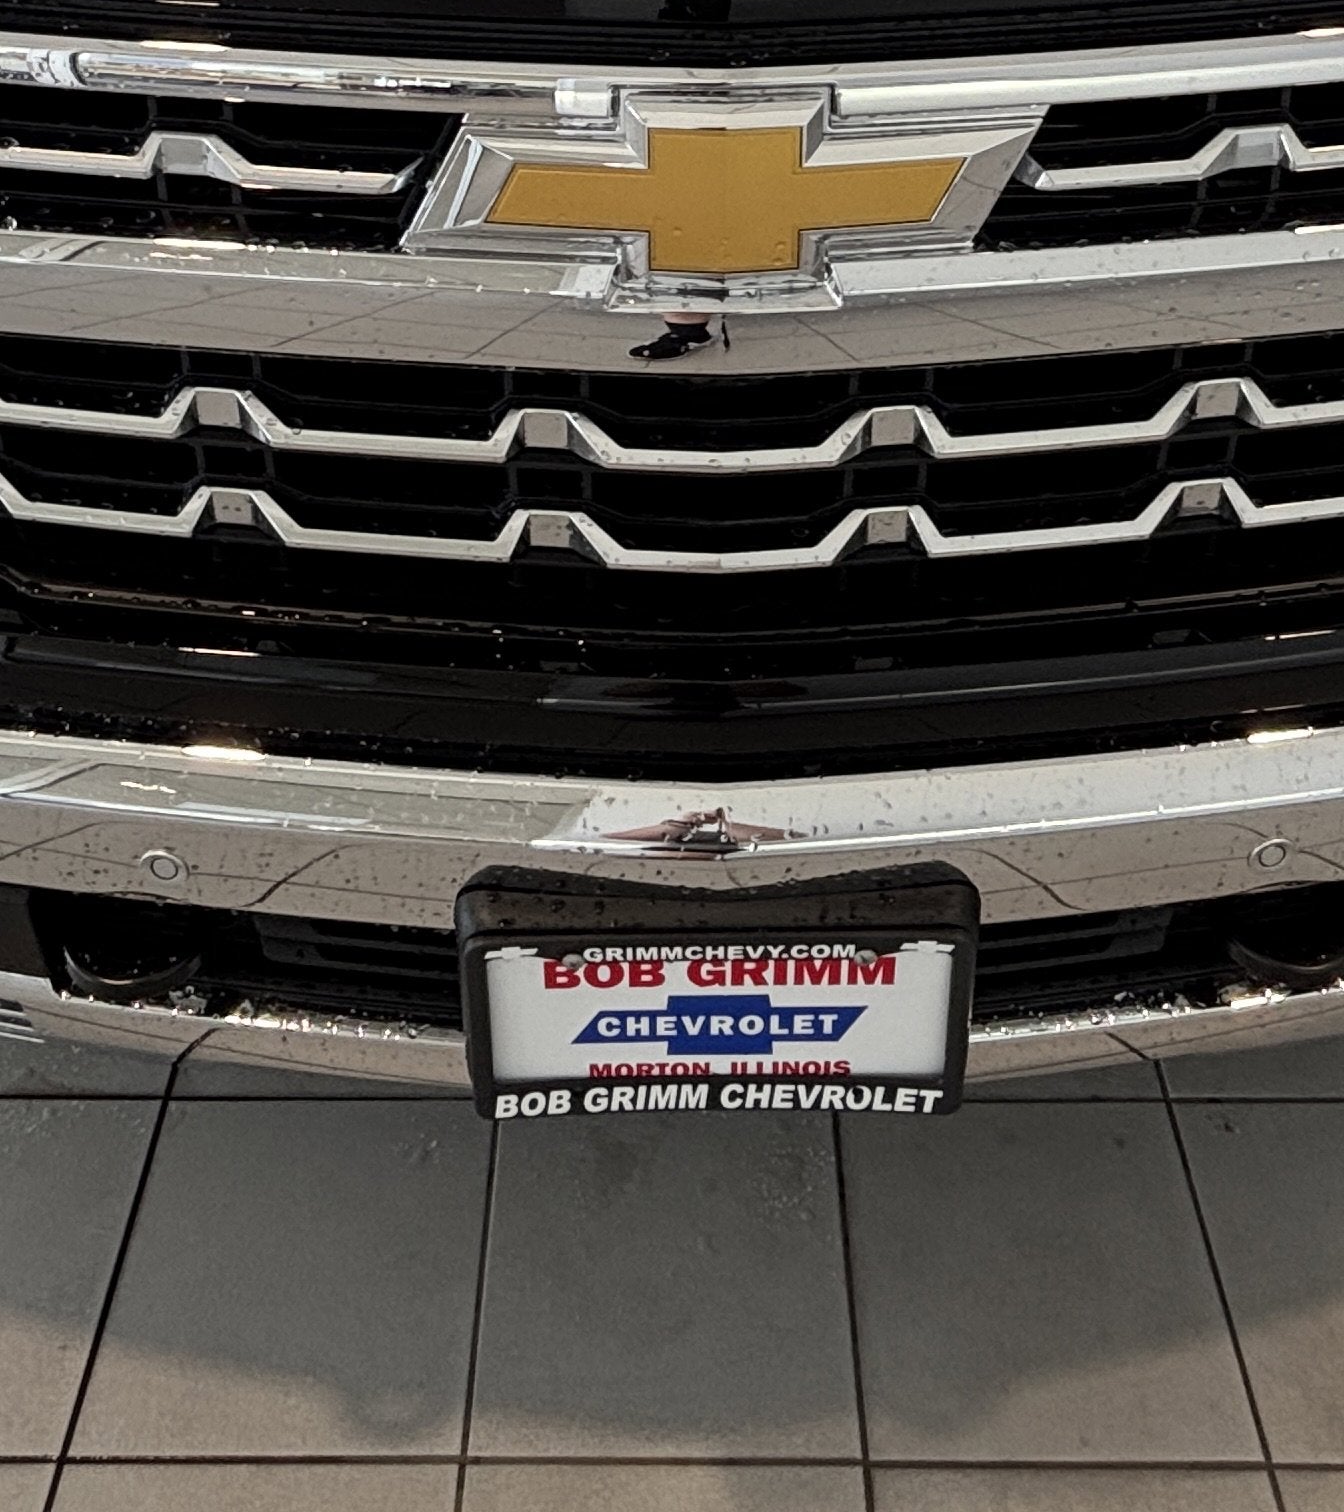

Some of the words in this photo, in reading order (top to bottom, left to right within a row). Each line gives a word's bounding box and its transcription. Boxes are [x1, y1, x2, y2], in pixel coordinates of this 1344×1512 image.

[583, 944, 856, 963] GRIMMCHEVY.COM
[544, 960, 666, 989] BOB
[687, 957, 896, 988] GRIMM
[597, 1013, 838, 1037] CHEVROLET
[495, 1090, 572, 1119] BOB
[583, 1084, 709, 1114] GRIMM
[720, 1083, 944, 1114] CHEVROLET
